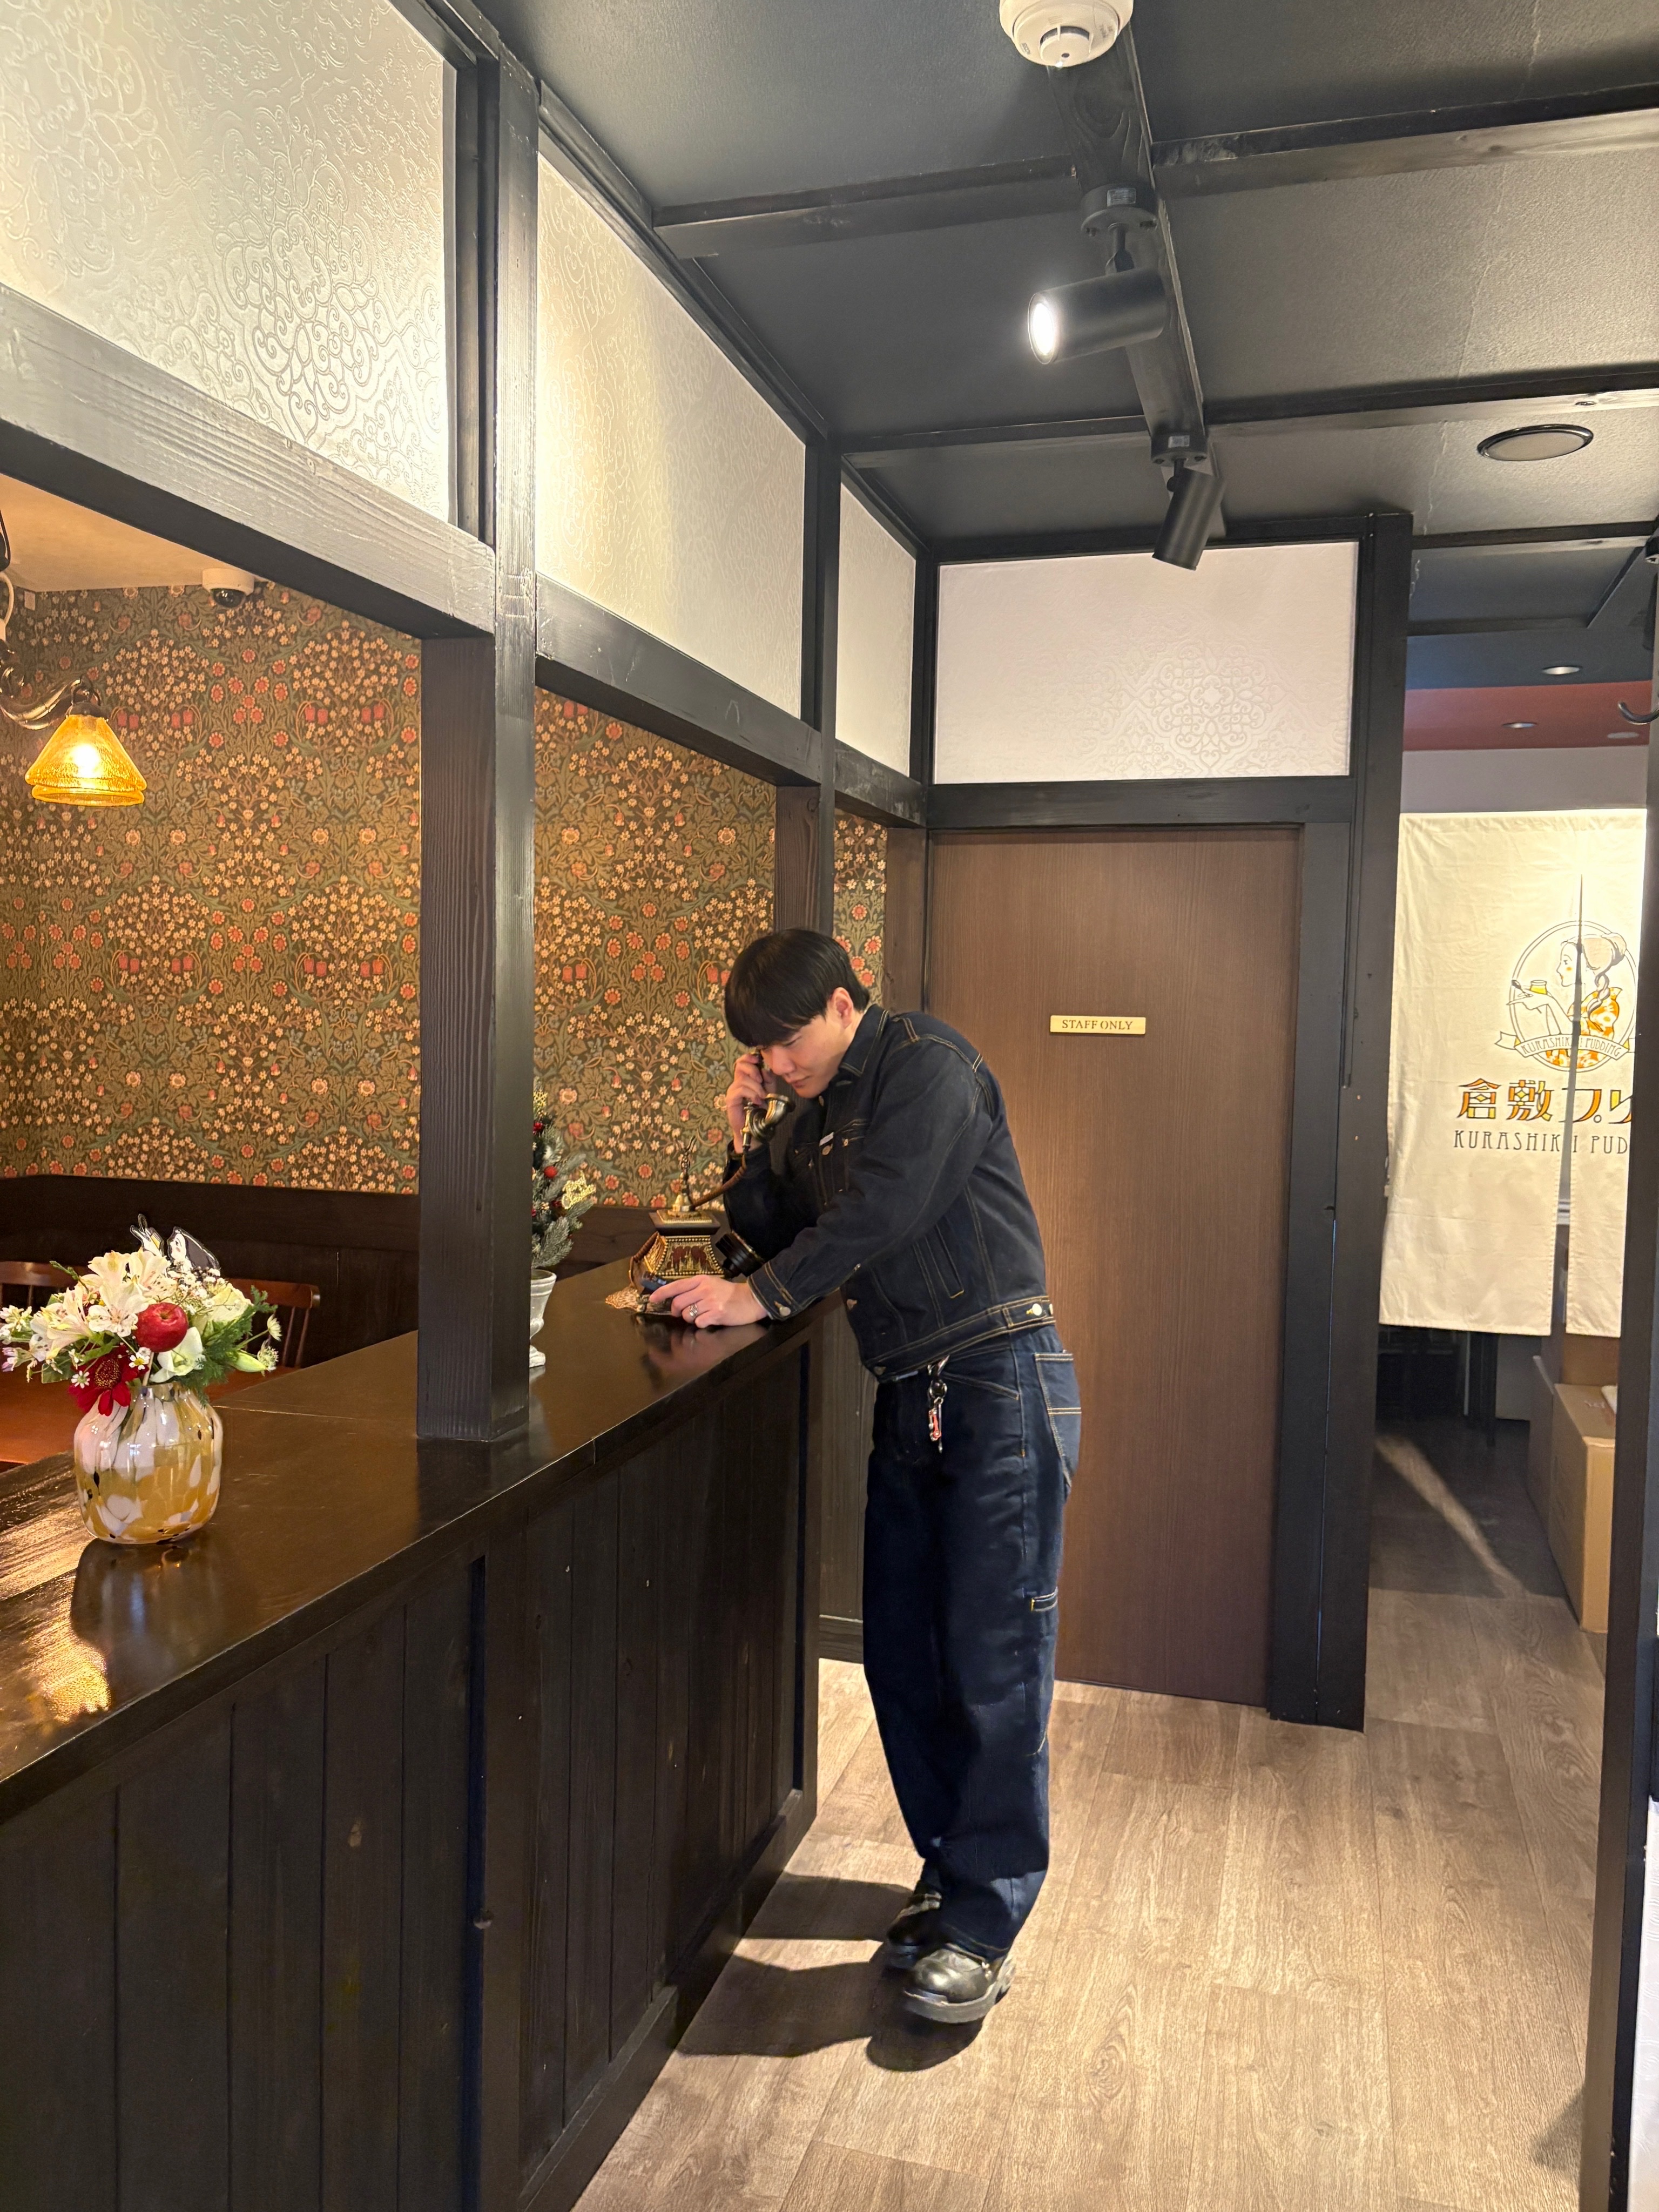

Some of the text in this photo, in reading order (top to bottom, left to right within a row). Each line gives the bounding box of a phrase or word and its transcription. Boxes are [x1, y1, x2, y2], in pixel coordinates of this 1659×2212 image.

[1062, 1020, 1132, 1030] STAFF ONLY
[1586, 1039, 1621, 1057] PUDDING
[1454, 1130, 1577, 1153] KURASHIKI
